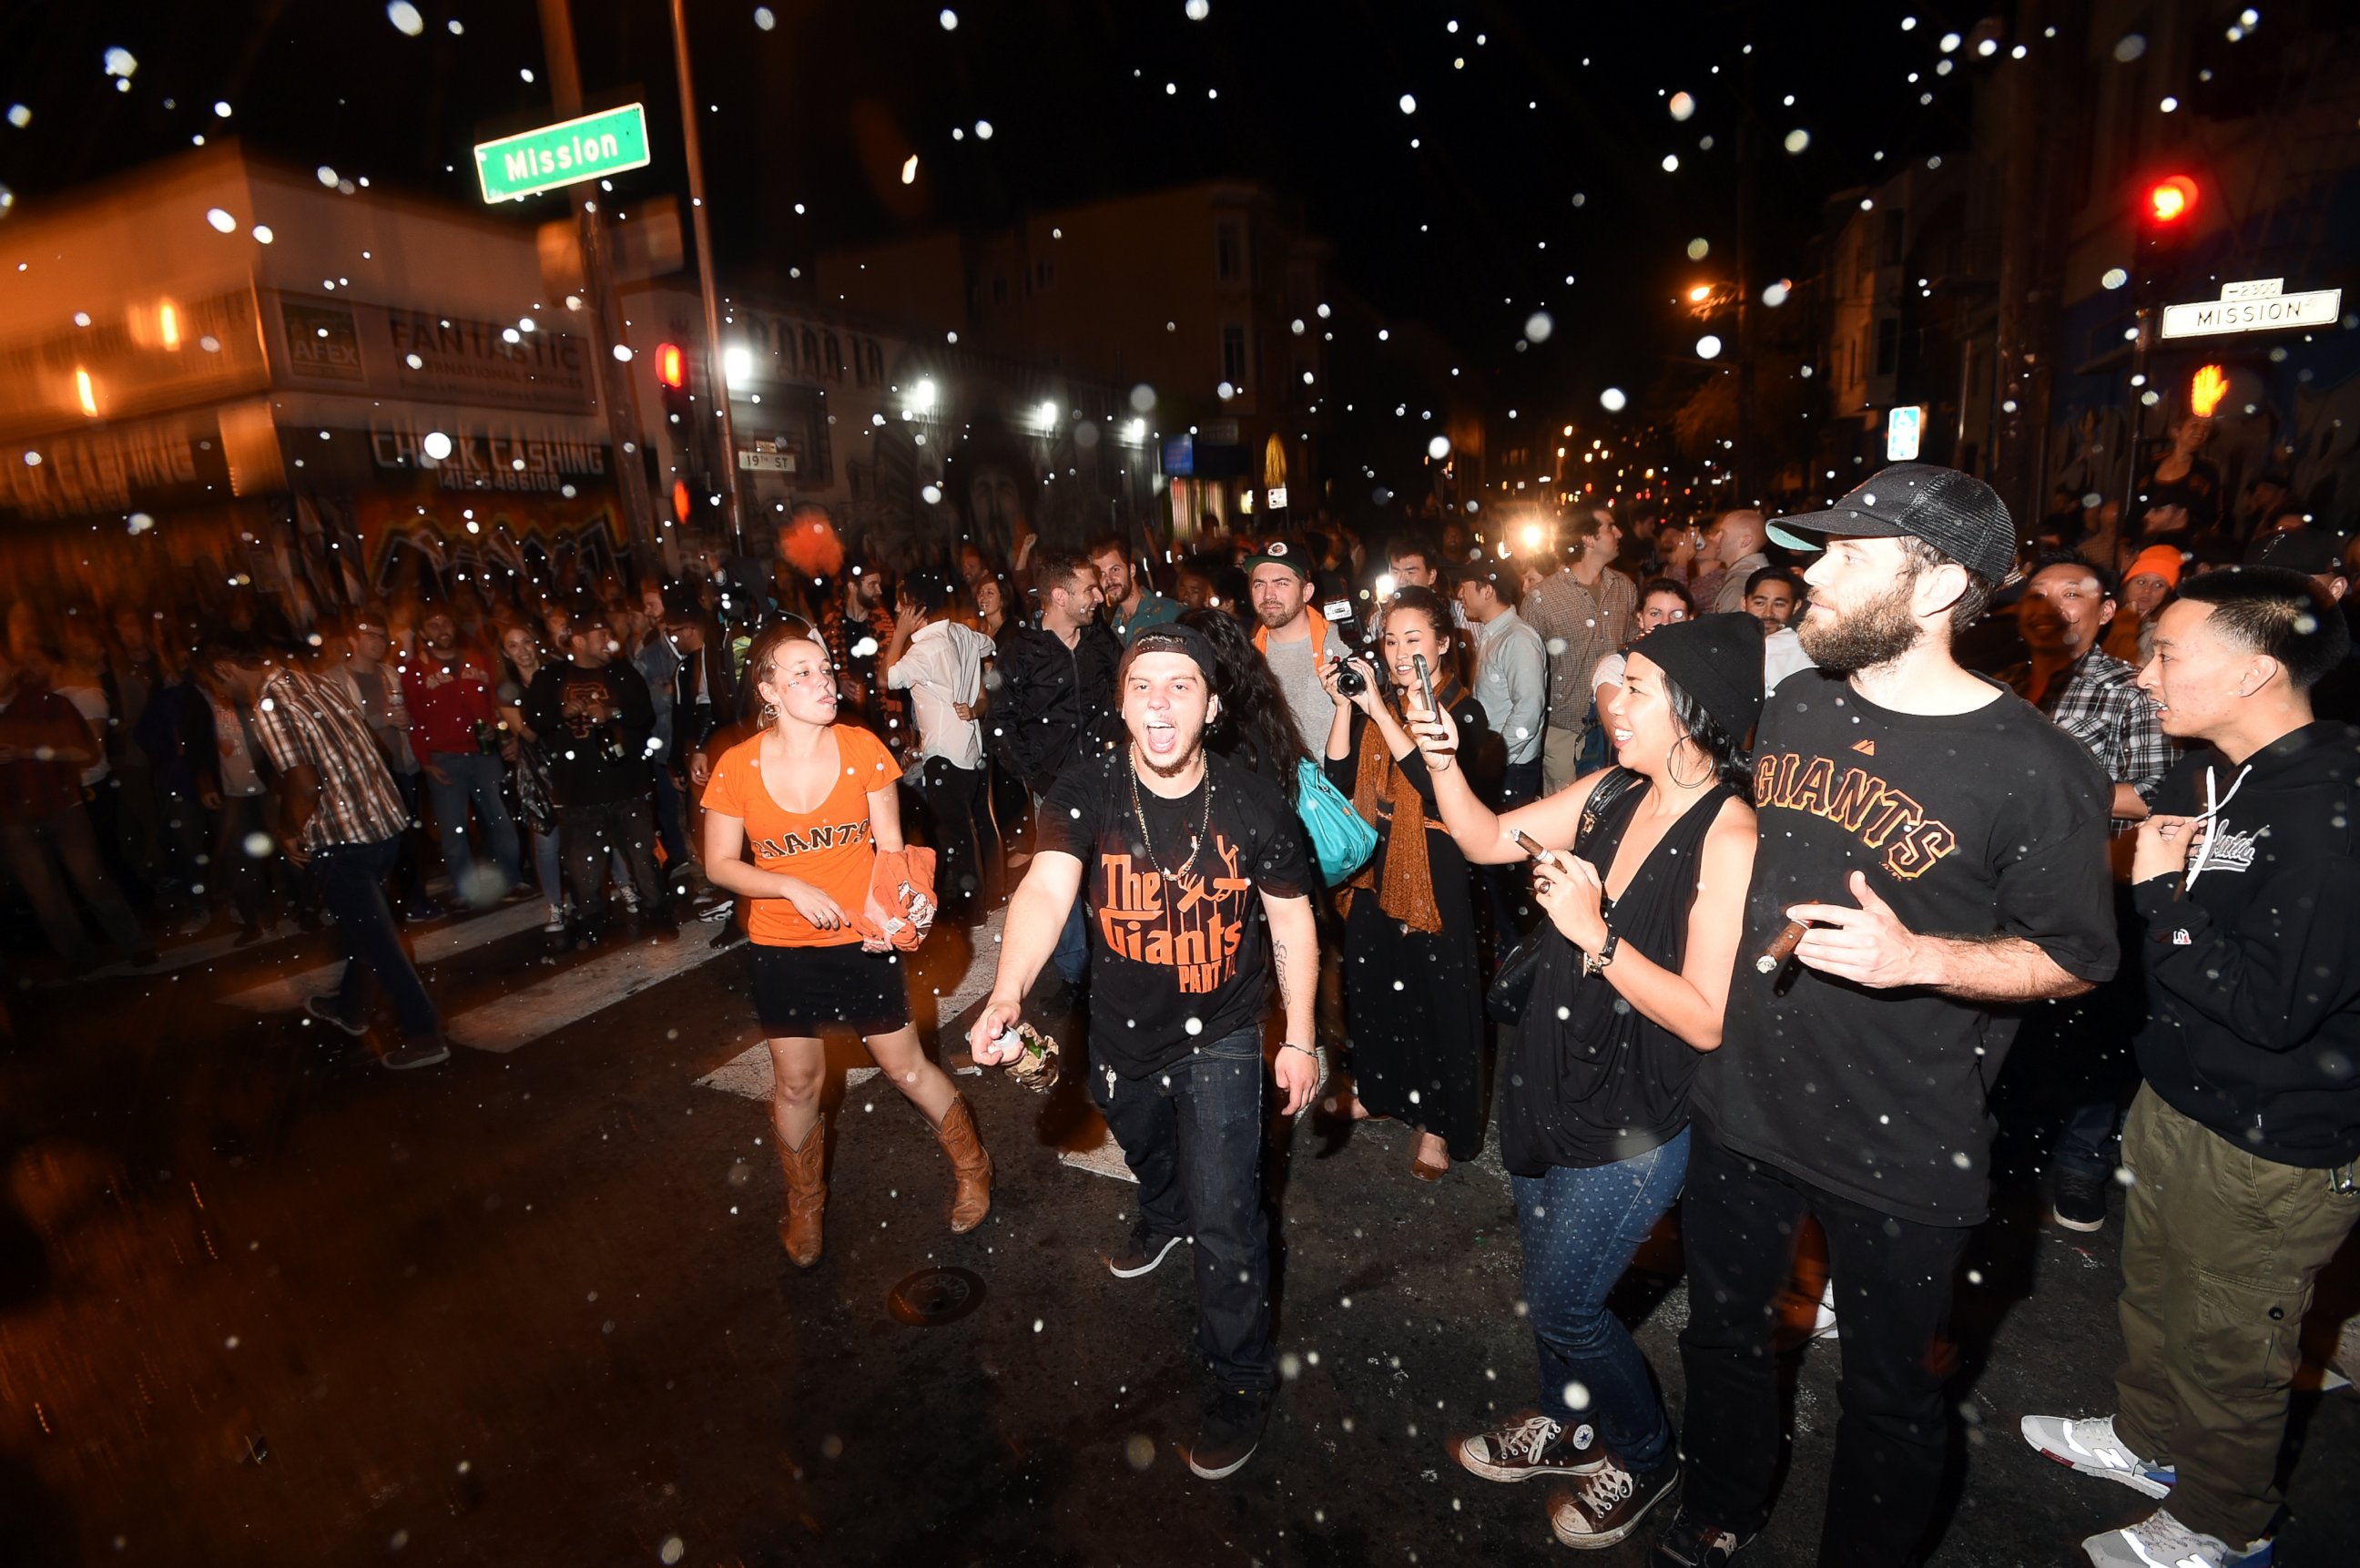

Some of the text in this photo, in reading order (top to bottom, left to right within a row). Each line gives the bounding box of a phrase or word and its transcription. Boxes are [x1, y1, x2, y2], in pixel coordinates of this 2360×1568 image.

[504, 134, 618, 182] Mission
[2196, 301, 2302, 327] MISSION
[293, 340, 359, 366] AFEX
[389, 316, 580, 372] FANTASTIC
[396, 356, 521, 382] INERNATIONAL
[370, 430, 605, 475] CHCK CASHING
[775, 457, 788, 468] ST
[1755, 753, 1957, 879] GIANTS
[1101, 853, 1162, 911] The
[1099, 907, 1243, 966] Giants
[1178, 961, 1222, 993] PART
